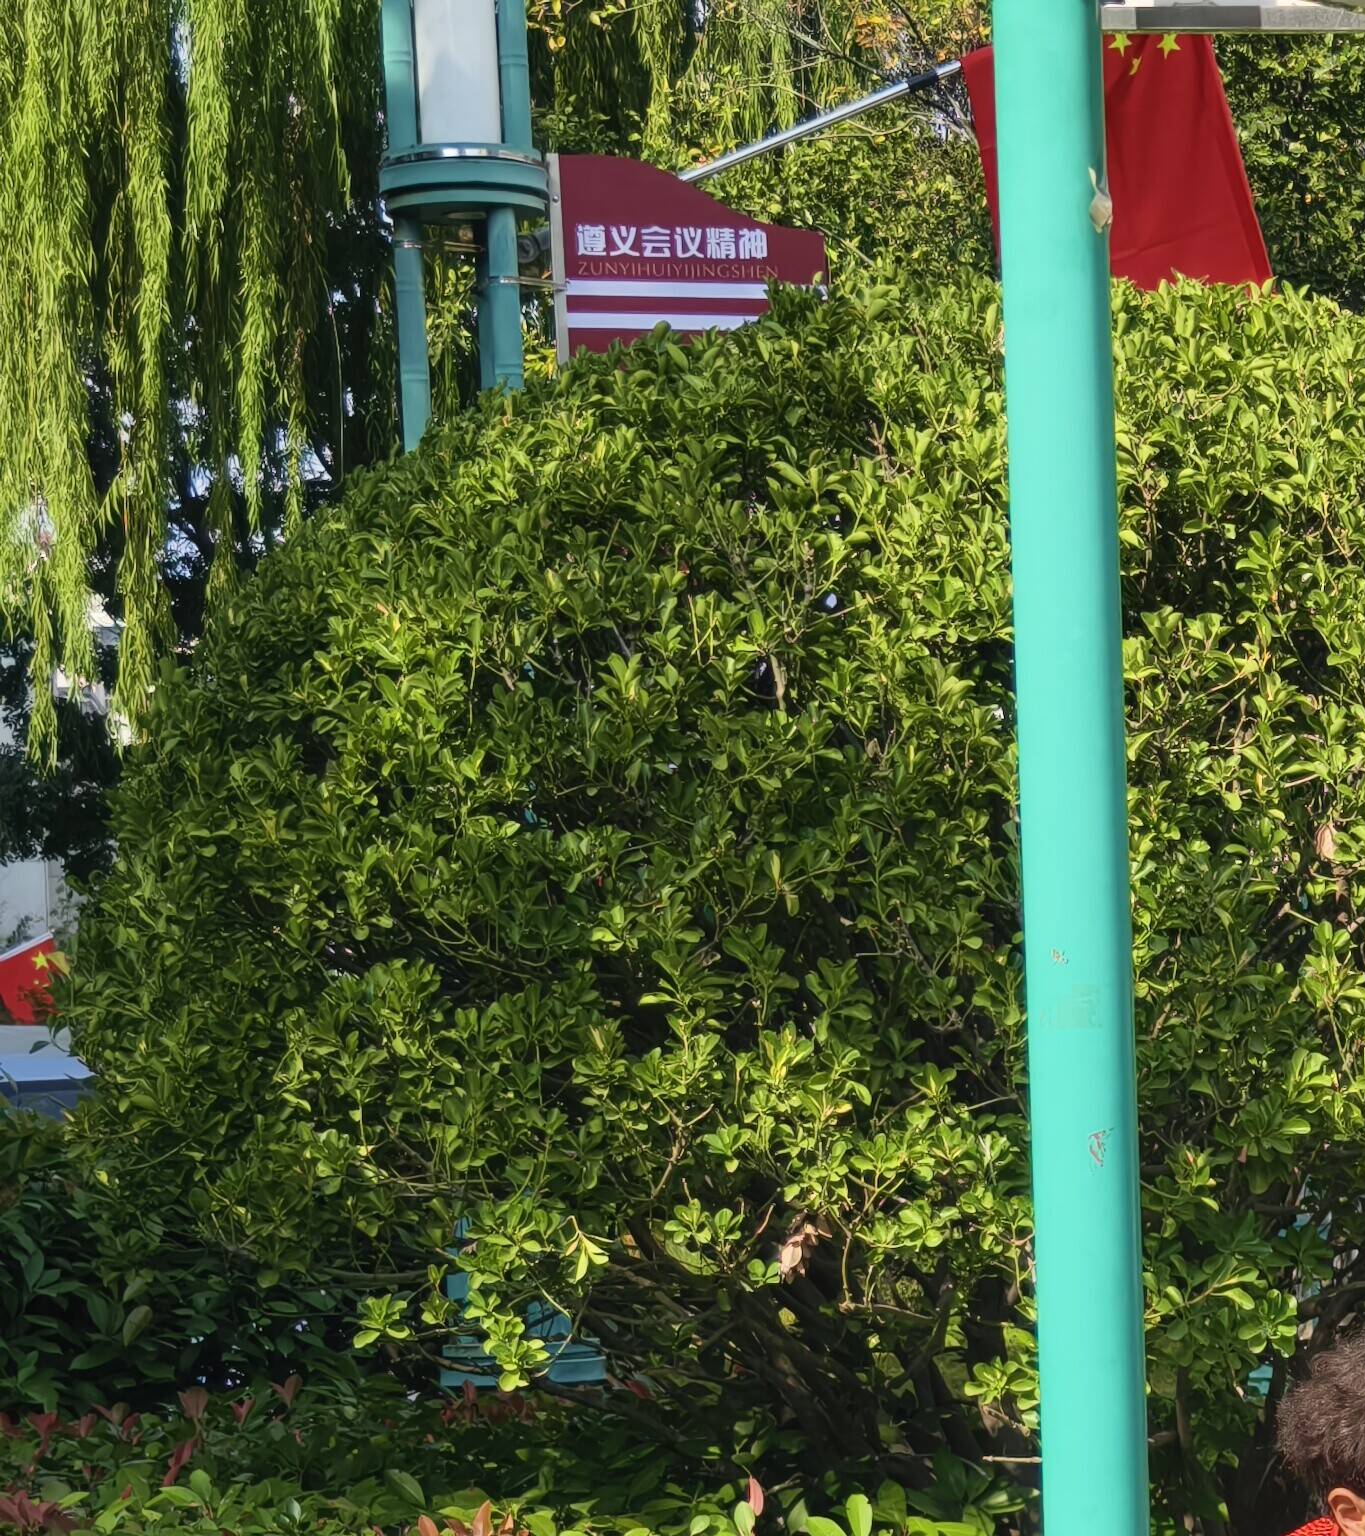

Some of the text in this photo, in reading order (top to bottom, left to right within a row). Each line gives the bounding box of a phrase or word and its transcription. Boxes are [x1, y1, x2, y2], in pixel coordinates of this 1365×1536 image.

[577, 224, 768, 259] 遵义会议精神
